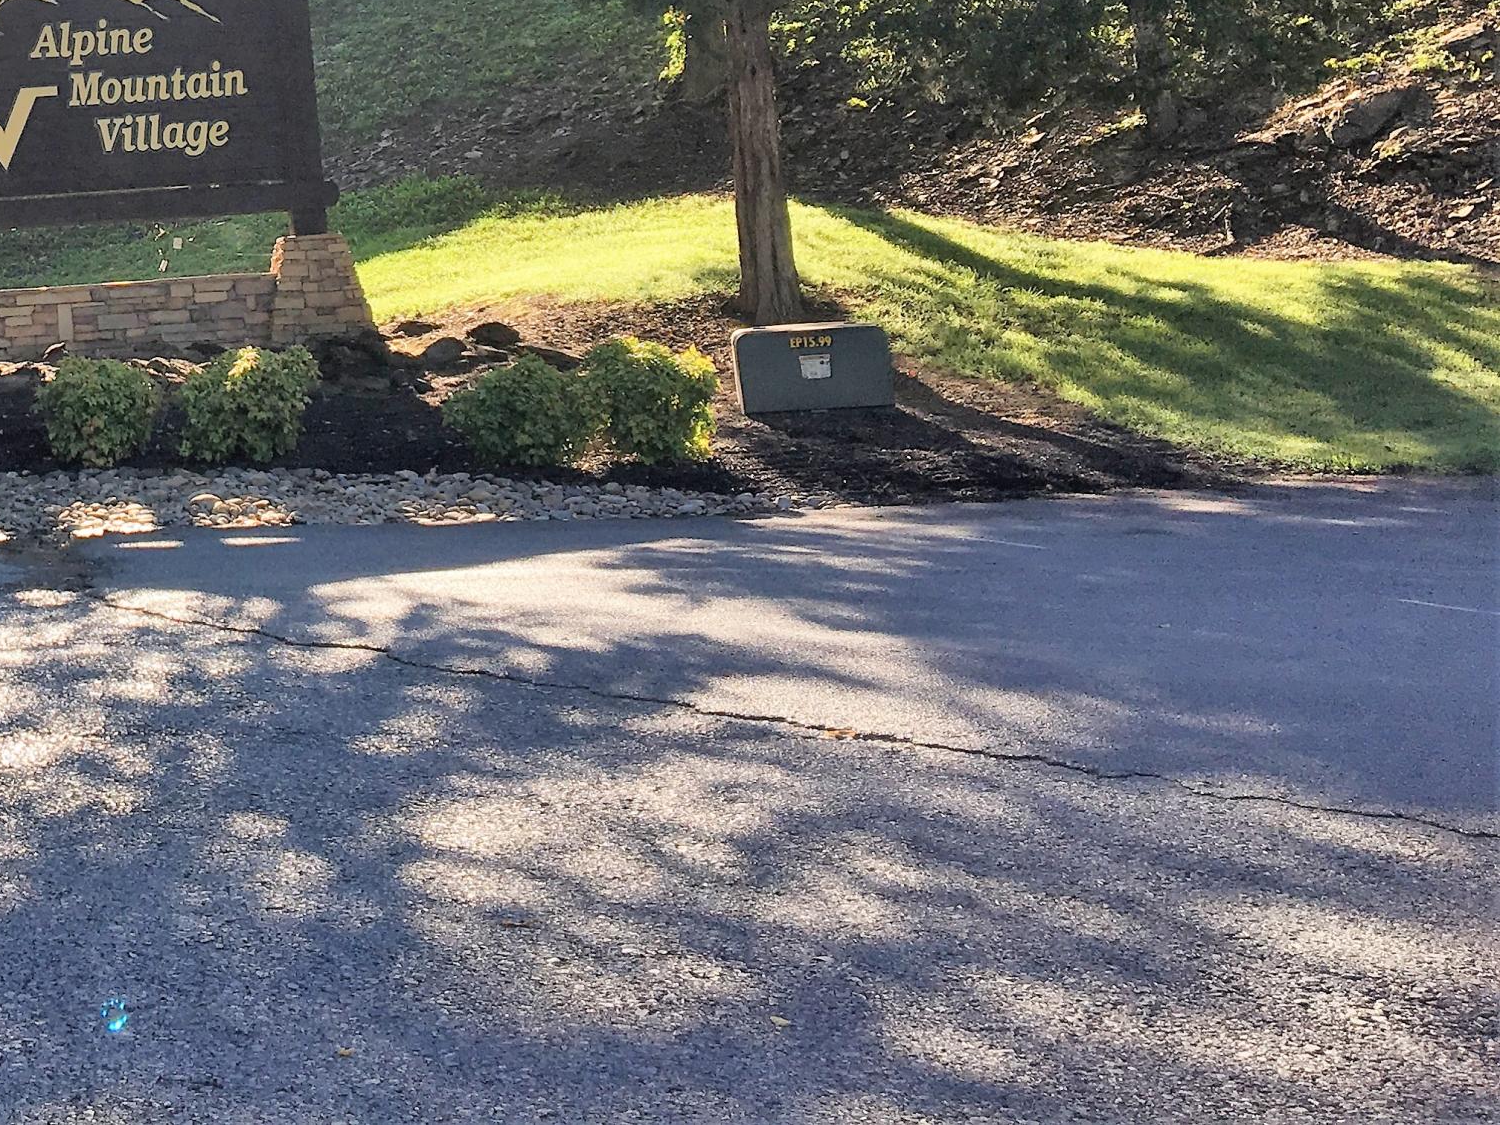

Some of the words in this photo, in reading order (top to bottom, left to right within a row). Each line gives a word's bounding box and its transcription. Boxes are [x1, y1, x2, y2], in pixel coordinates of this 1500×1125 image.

[31, 20, 153, 66] Alpine
[70, 60, 246, 106] Mountain
[98, 114, 229, 156] Village
